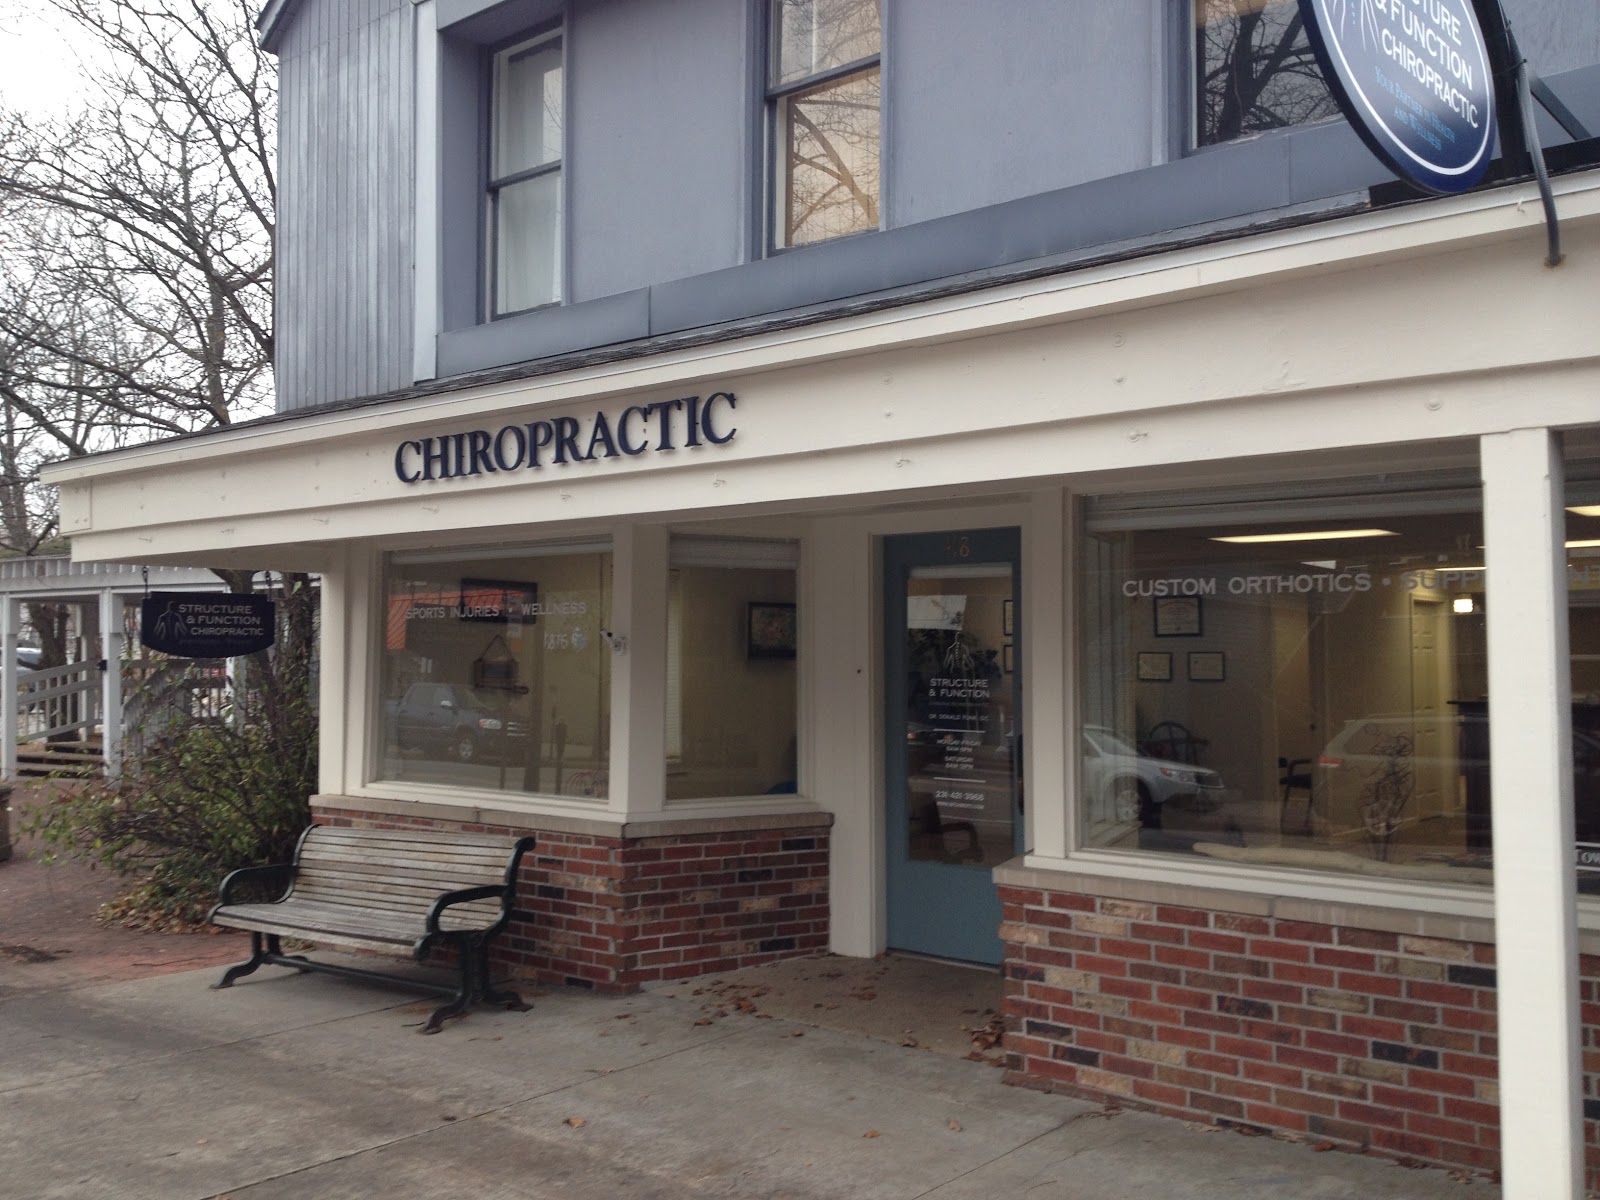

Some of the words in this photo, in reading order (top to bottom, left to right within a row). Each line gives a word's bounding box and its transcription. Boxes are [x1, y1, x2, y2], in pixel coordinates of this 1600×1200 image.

[1390, 0, 1473, 91] FUNCTION
[1381, 28, 1479, 128] CHIROPRACTIC
[395, 392, 737, 484] CHIROPRACTIC
[1122, 577, 1217, 597] CUSTOM
[1228, 573, 1372, 595] ORTHOTICS
[1399, 569, 1485, 591] SUPP
[178, 603, 253, 614] STRUCTURE
[405, 606, 446, 619] SPORTS
[450, 604, 500, 618] INJURIES
[521, 602, 587, 616] WELLNESS
[186, 615, 196, 625] &
[198, 615, 261, 625] FUNCTION
[190, 627, 264, 636] CHIROPRACTIC
[929, 678, 989, 688] STRUCTURE
[928, 688, 937, 697] &
[939, 688, 990, 698] FUNCTION
